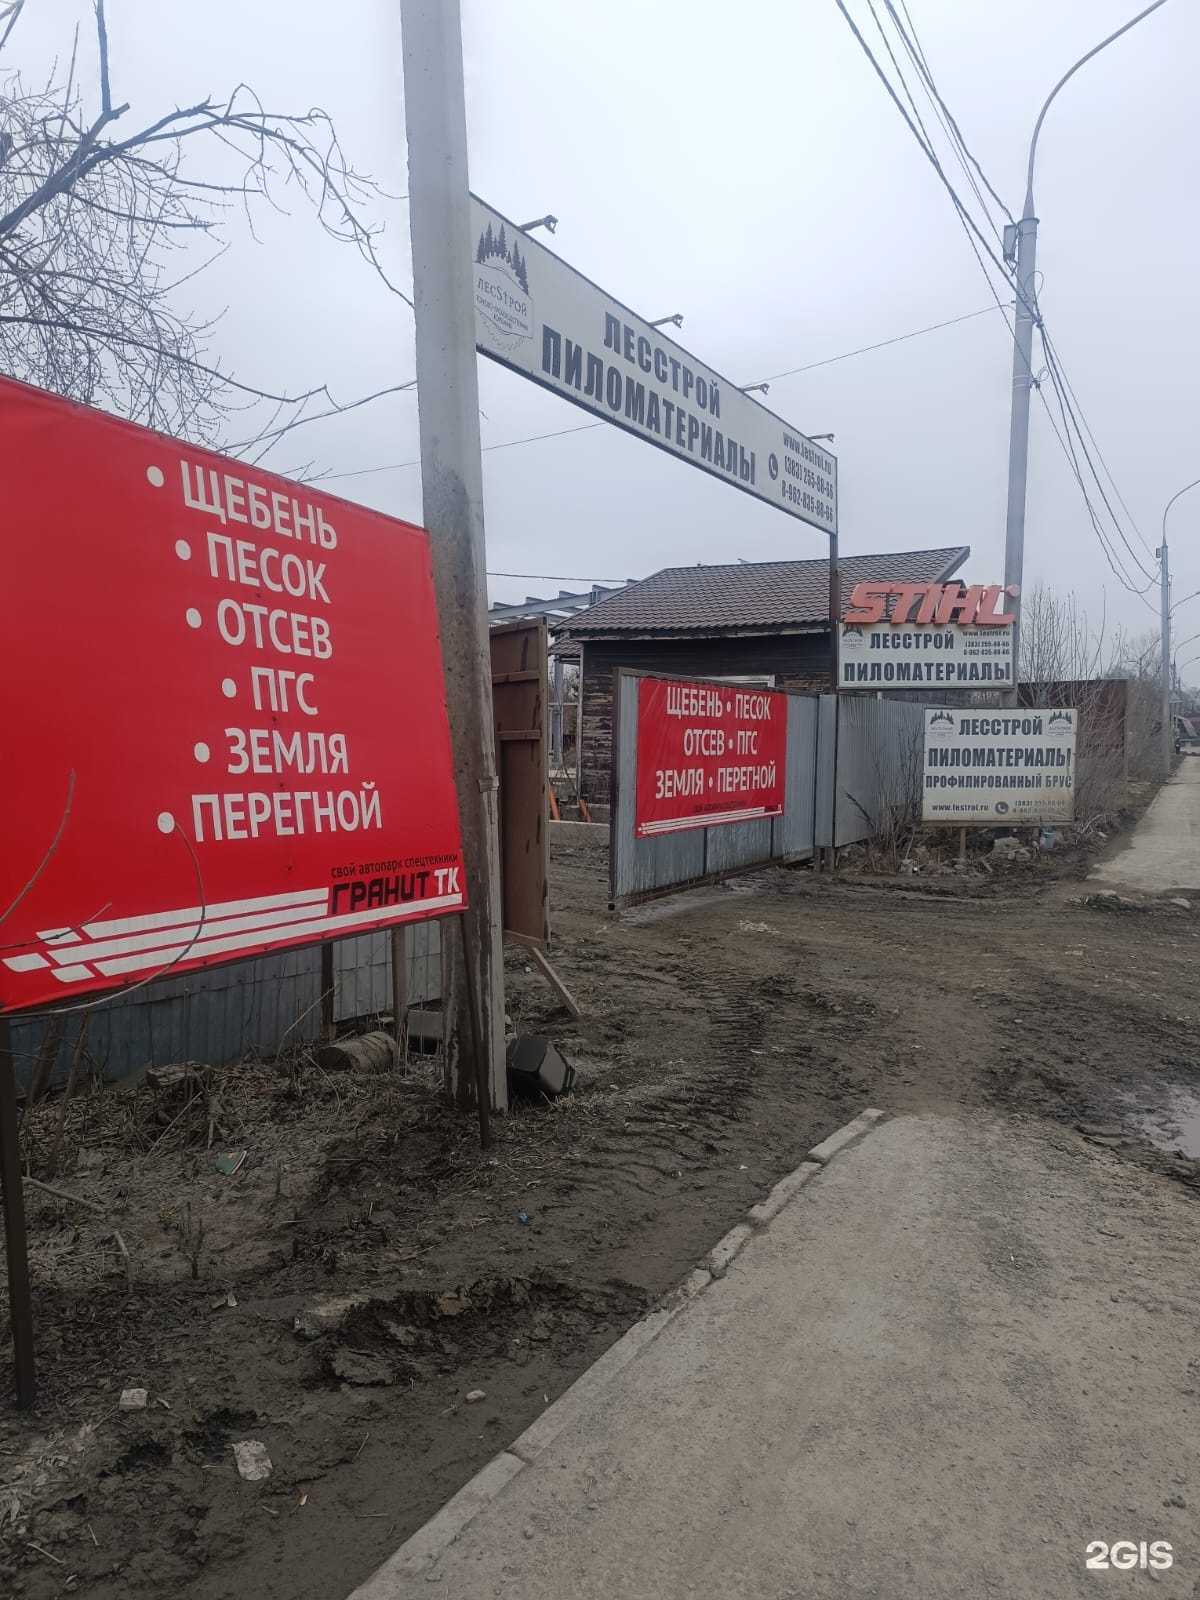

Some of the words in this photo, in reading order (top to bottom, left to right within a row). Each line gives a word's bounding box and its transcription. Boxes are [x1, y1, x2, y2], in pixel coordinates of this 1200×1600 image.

[604, 311, 720, 419] ЛЕССТРОЙ
[542, 323, 756, 486] ПИЛОМАТЕРИАЛЫ
[181, 459, 338, 551] ЩЕБЕНЬ
[206, 532, 332, 604] ПЕСОК
[843, 583, 1016, 625] STIHL
[217, 599, 333, 660] ОТСЕВ
[870, 630, 954, 649] ЛЕССТРОЙ
[251, 666, 319, 716] ПГС
[844, 662, 1010, 681] ПИЛОМАТЕРИАЛЫ
[666, 686, 723, 720] ЩЕБЕНЬ
[735, 694, 771, 720] ПЕСОК
[684, 729, 725, 756] ОТСЕВ
[737, 731, 758, 755] ПГС
[959, 716, 1042, 736] ЛЕССТРОЙ
[224, 728, 349, 774] ЗЕМЛЯ
[928, 747, 1071, 767] ПИЛОМАТЕРИАЛЫ
[655, 768, 704, 799] ЗЕМЛЯ
[717, 760, 776, 793] ПЕРЕГНОЙ
[926, 773, 1042, 788] ПРОФИЛИРОВАННЫЙ
[1045, 774, 1072, 788] БРУС
[191, 781, 383, 842] ПЕРЕГНОЙ
[331, 862, 355, 878] свой
[404, 854, 458, 868] спецтехники
[332, 871, 430, 914] ГРАНИТ
[434, 867, 460, 895] ТК
